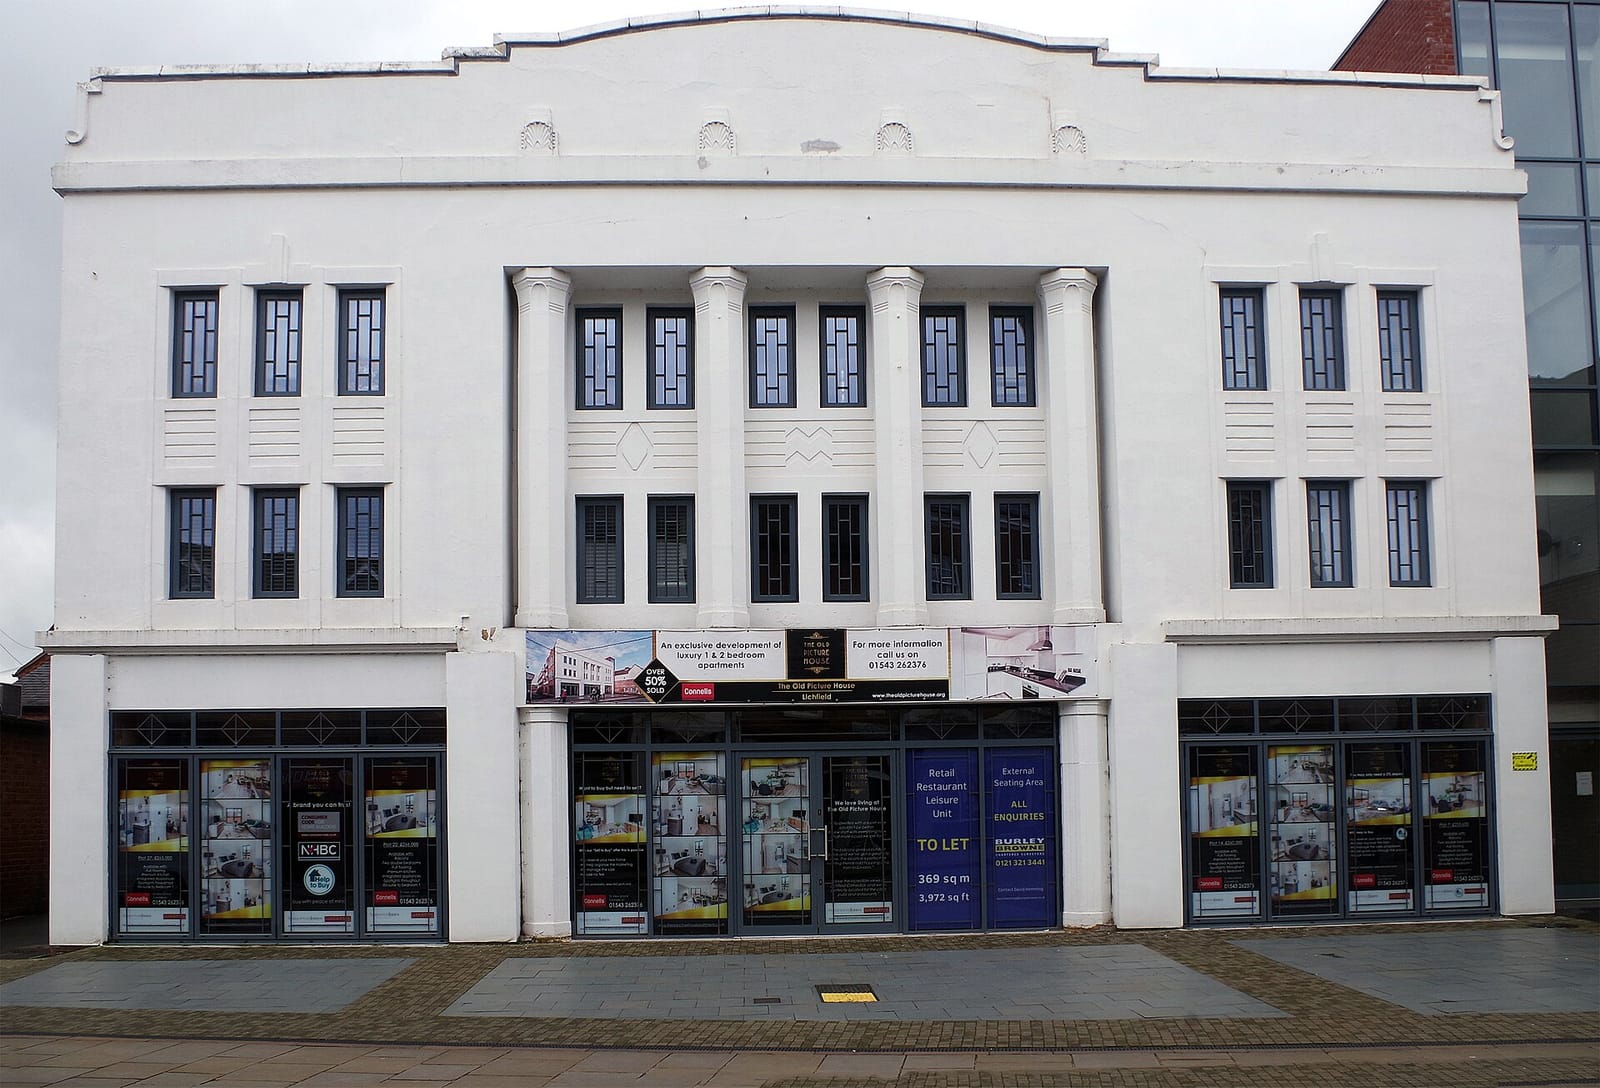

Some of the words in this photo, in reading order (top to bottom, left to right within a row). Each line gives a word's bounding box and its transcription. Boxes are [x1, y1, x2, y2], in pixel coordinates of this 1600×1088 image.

[716, 642, 771, 651] development
[773, 641, 782, 649] of
[853, 640, 866, 649] For
[893, 639, 943, 648] information
[677, 652, 702, 660] luxury
[727, 651, 765, 659] bedroom
[803, 649, 829, 657] PICTURE
[877, 650, 893, 659] call
[698, 662, 745, 671] apartments
[869, 661, 894, 669] 01543
[897, 661, 927, 669] 262376
[644, 676, 666, 687] 50%
[646, 687, 665, 695] SOLD
[684, 687, 712, 695] Connells
[929, 768, 955, 778] Retail
[1002, 767, 1035, 776] External
[916, 781, 967, 792] Restaurant
[994, 779, 1024, 788] Seating
[1025, 778, 1044, 786] Area
[926, 796, 959, 805] Leisure
[1010, 800, 1027, 808] ALL
[932, 809, 952, 818] Unit
[994, 812, 1044, 822] ENQUIRIES
[917, 838, 939, 851] TO
[942, 838, 970, 851] LET
[301, 844, 337, 856] NHBC
[995, 859, 1012, 867] 0121
[1027, 858, 1045, 866] 3441
[314, 875, 330, 884] Help
[918, 874, 940, 884] 369
[943, 875, 957, 885] sq
[960, 875, 970, 883] m
[919, 893, 945, 903] 3,972
[947, 894, 960, 904] sq
[961, 892, 970, 902] ft
